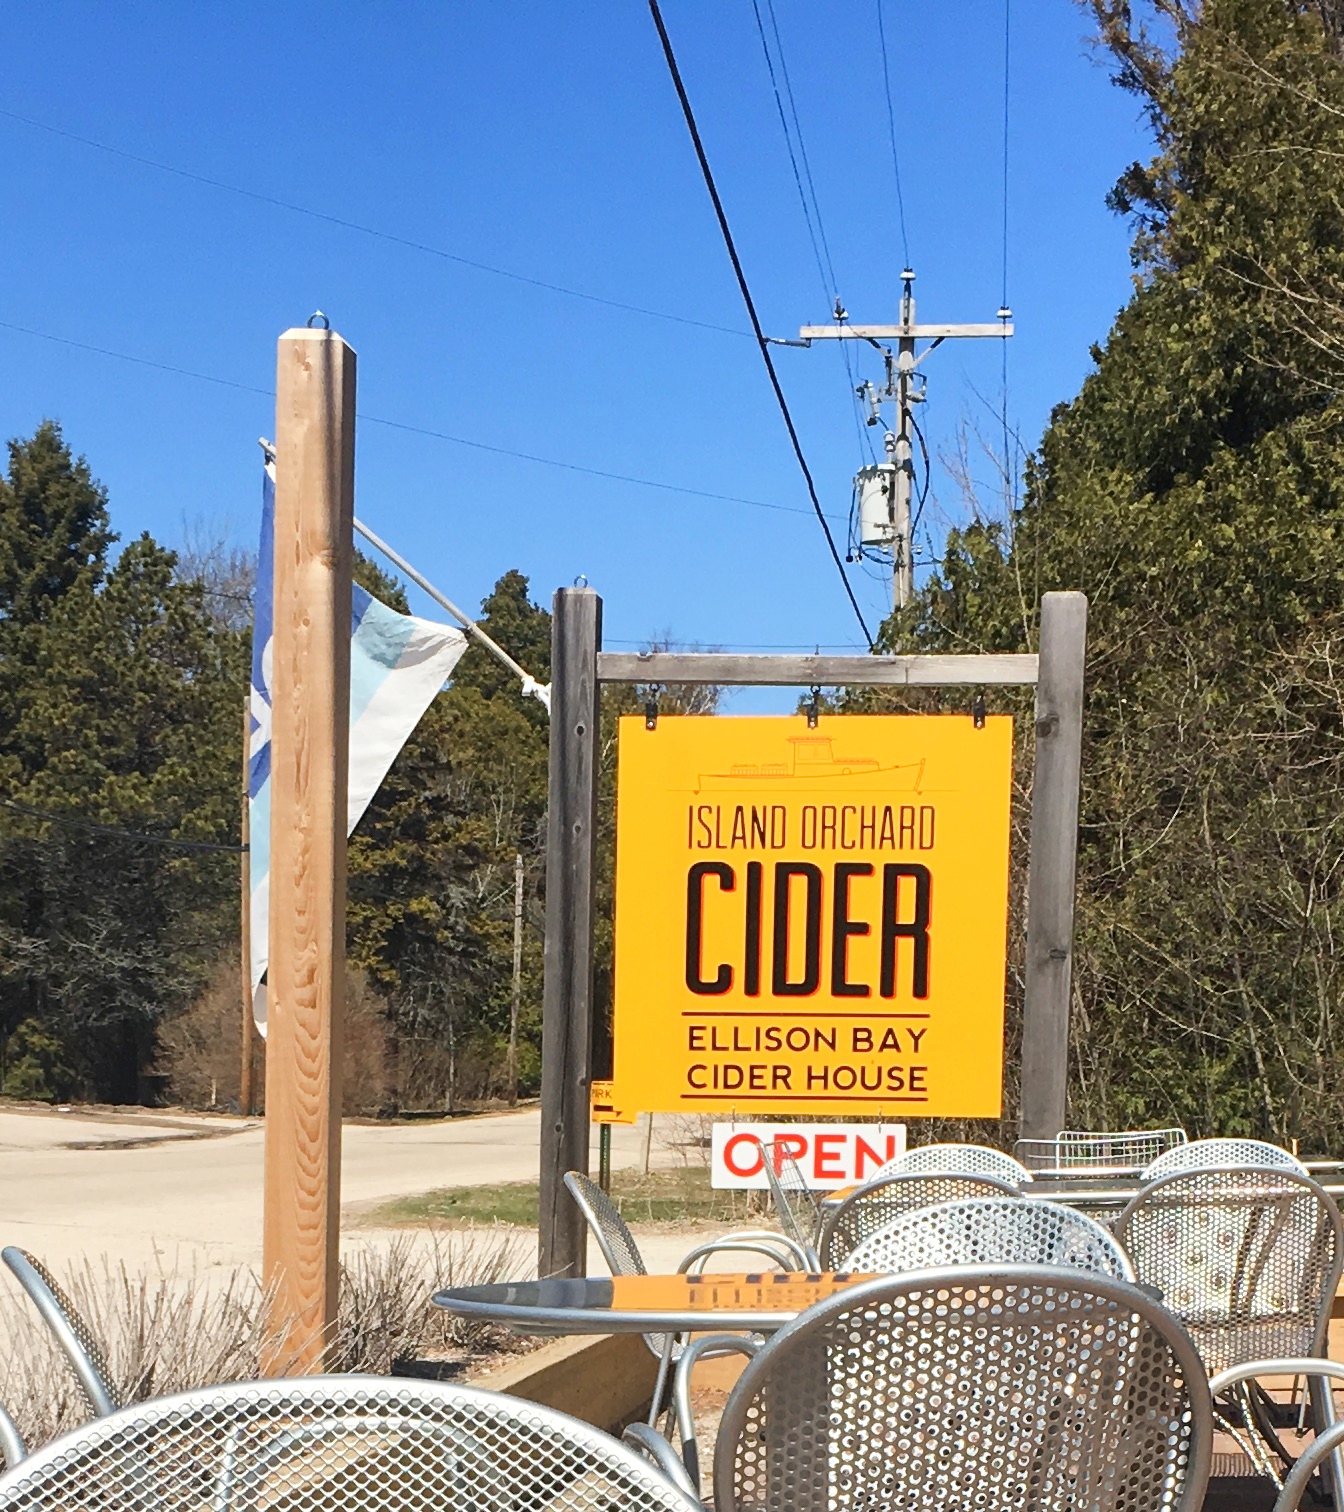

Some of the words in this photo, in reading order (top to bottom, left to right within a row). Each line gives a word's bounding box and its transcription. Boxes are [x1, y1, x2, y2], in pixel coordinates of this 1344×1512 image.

[688, 804, 787, 850] ISLAND
[801, 804, 936, 851] ORCHARD
[685, 860, 933, 1000] CIDER
[688, 1025, 837, 1053] ELLISON
[852, 1027, 928, 1054] BAY
[687, 1063, 792, 1091] CIDER
[807, 1064, 929, 1092] HOUSE
[723, 1133, 896, 1180] OPEN
